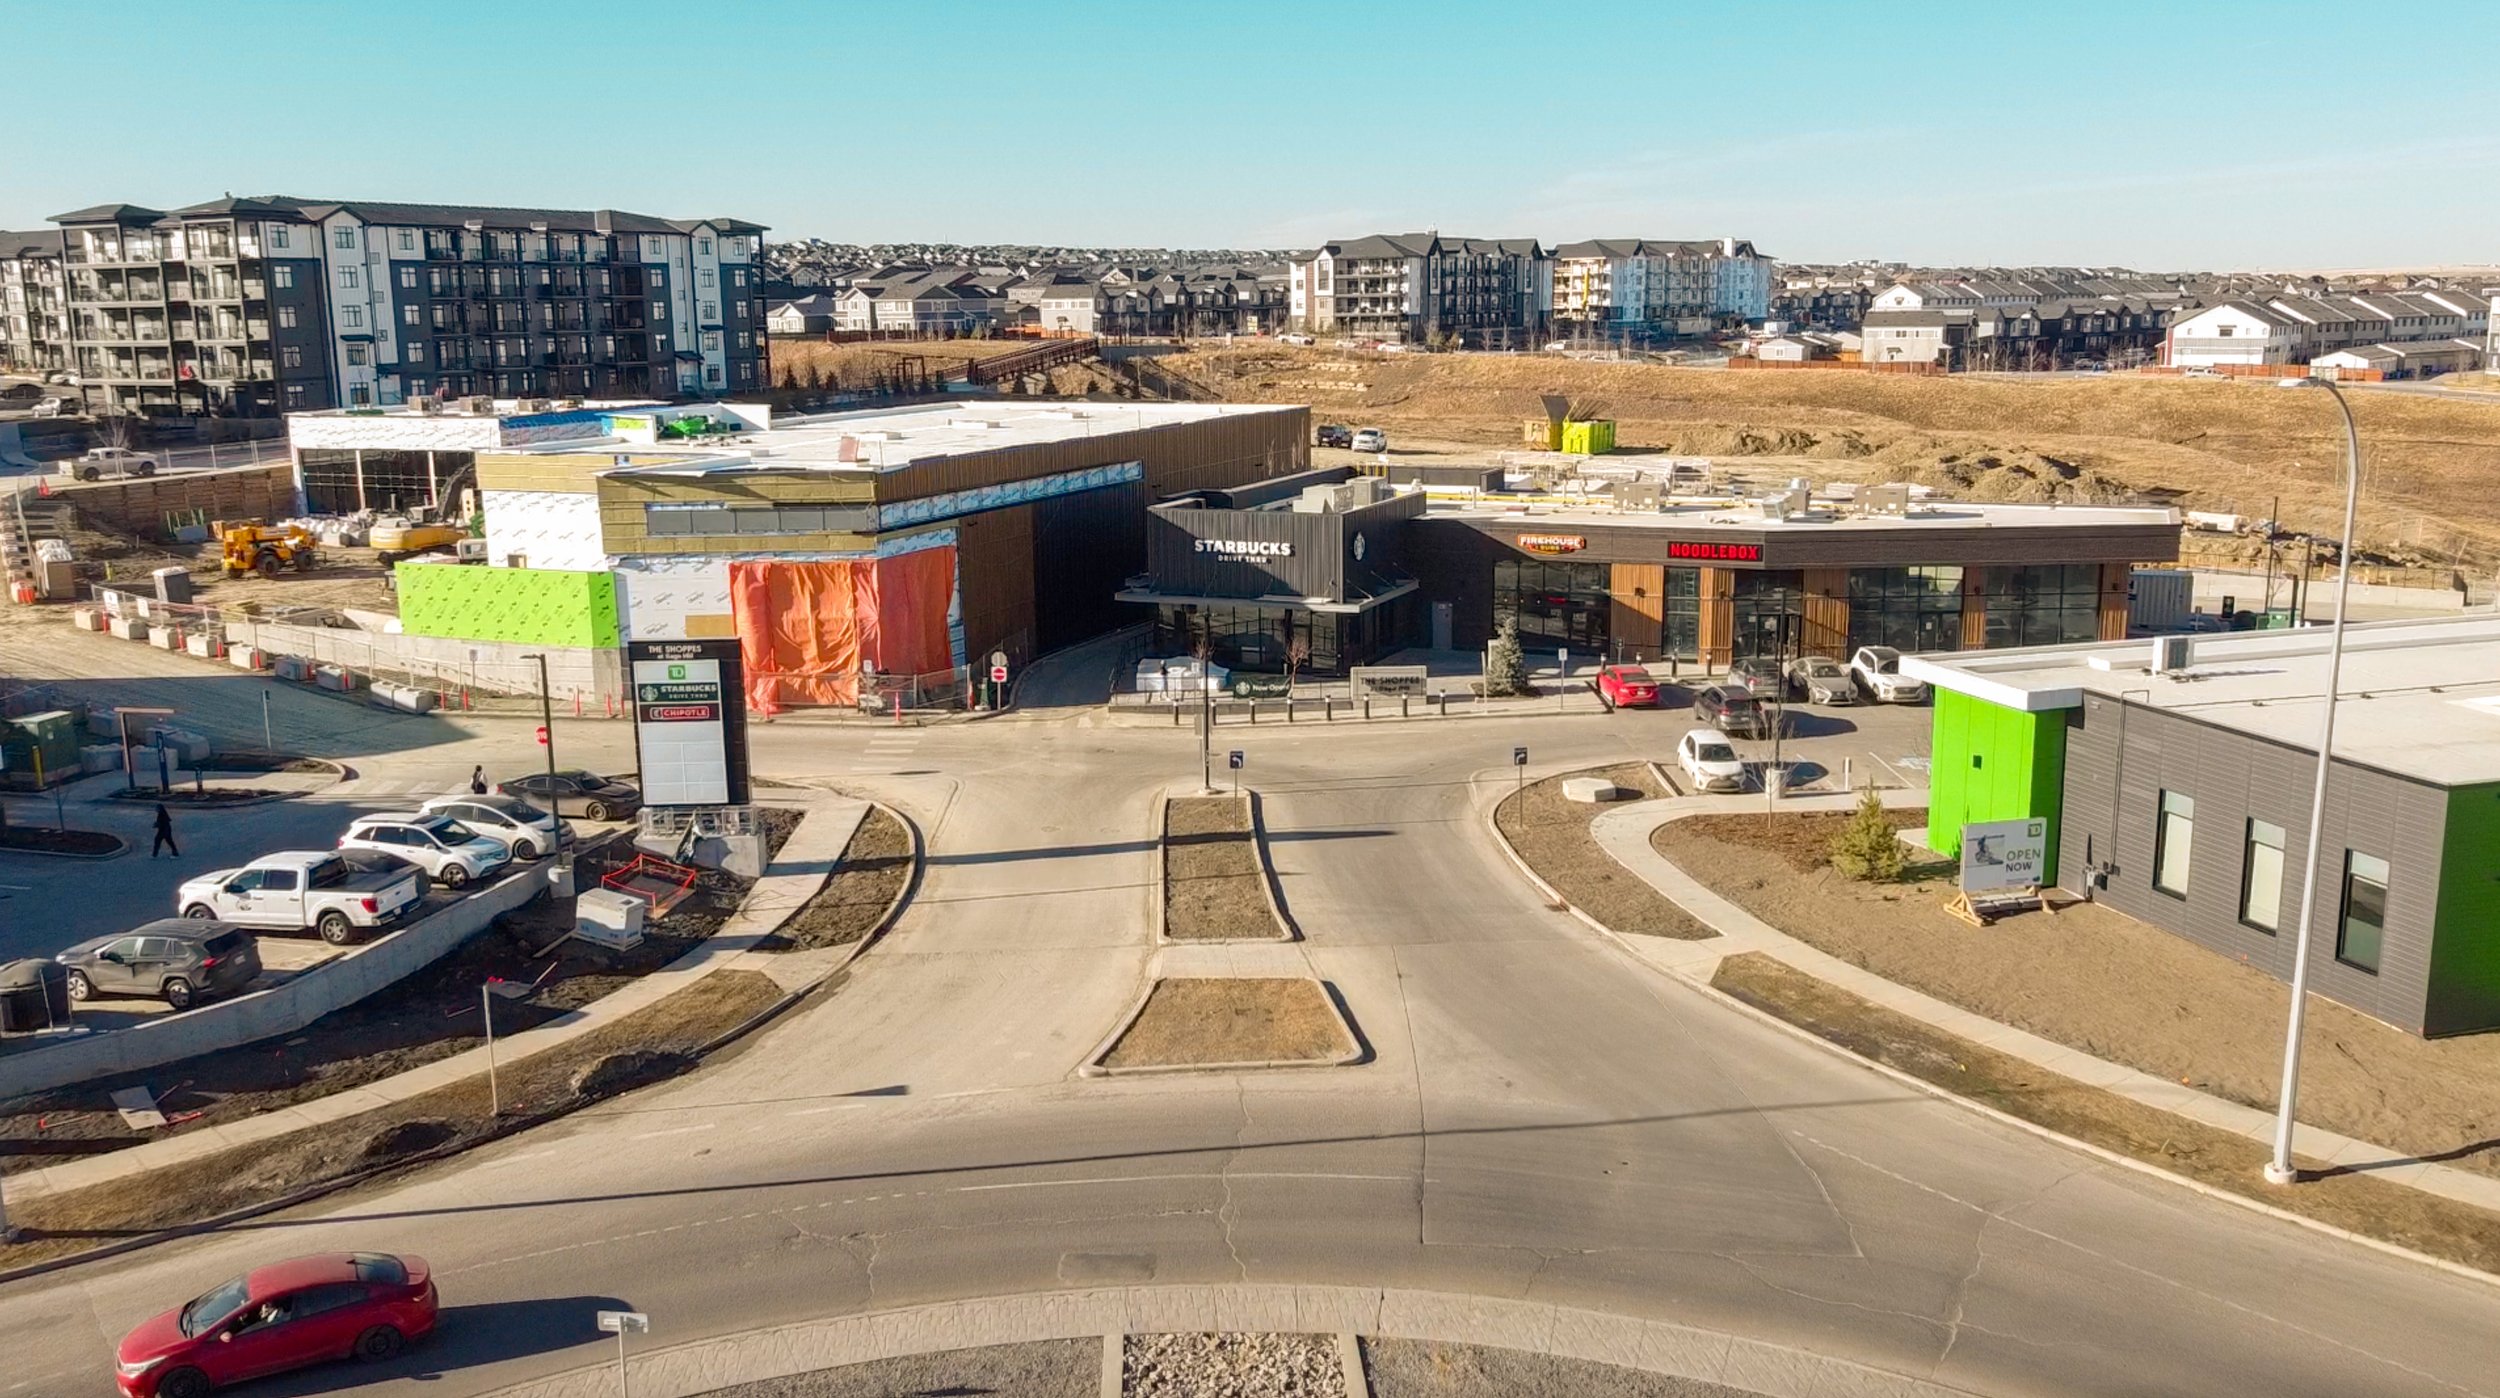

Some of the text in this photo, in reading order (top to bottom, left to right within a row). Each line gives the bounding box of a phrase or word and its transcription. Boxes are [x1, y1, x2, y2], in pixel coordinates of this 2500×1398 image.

[1520, 536, 1581, 546] FIREHOUSE
[1195, 540, 1290, 556] STARBUCKS
[1671, 543, 1758, 560] NOODLEBOX
[649, 645, 702, 653] THE SHOPPES
[661, 685, 717, 693] STARBUCKS
[2006, 849, 2041, 861] OPEN
[2006, 861, 2033, 872] NOW
